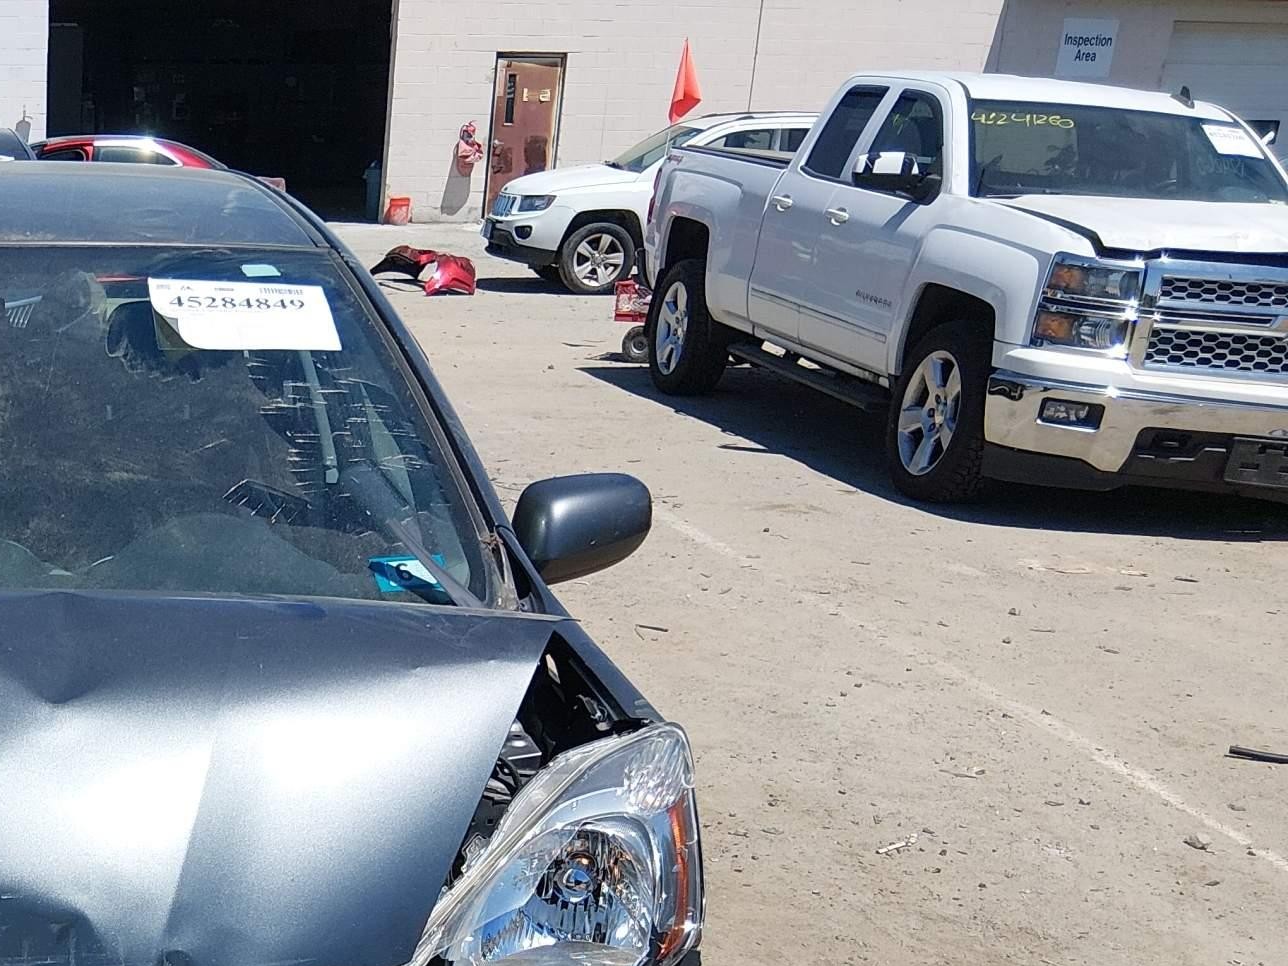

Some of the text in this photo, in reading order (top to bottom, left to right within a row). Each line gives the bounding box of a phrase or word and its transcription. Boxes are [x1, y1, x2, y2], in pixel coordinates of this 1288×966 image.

[1063, 32, 1113, 48] Inspection
[1074, 48, 1097, 62] Area
[169, 295, 305, 310] 45284849
